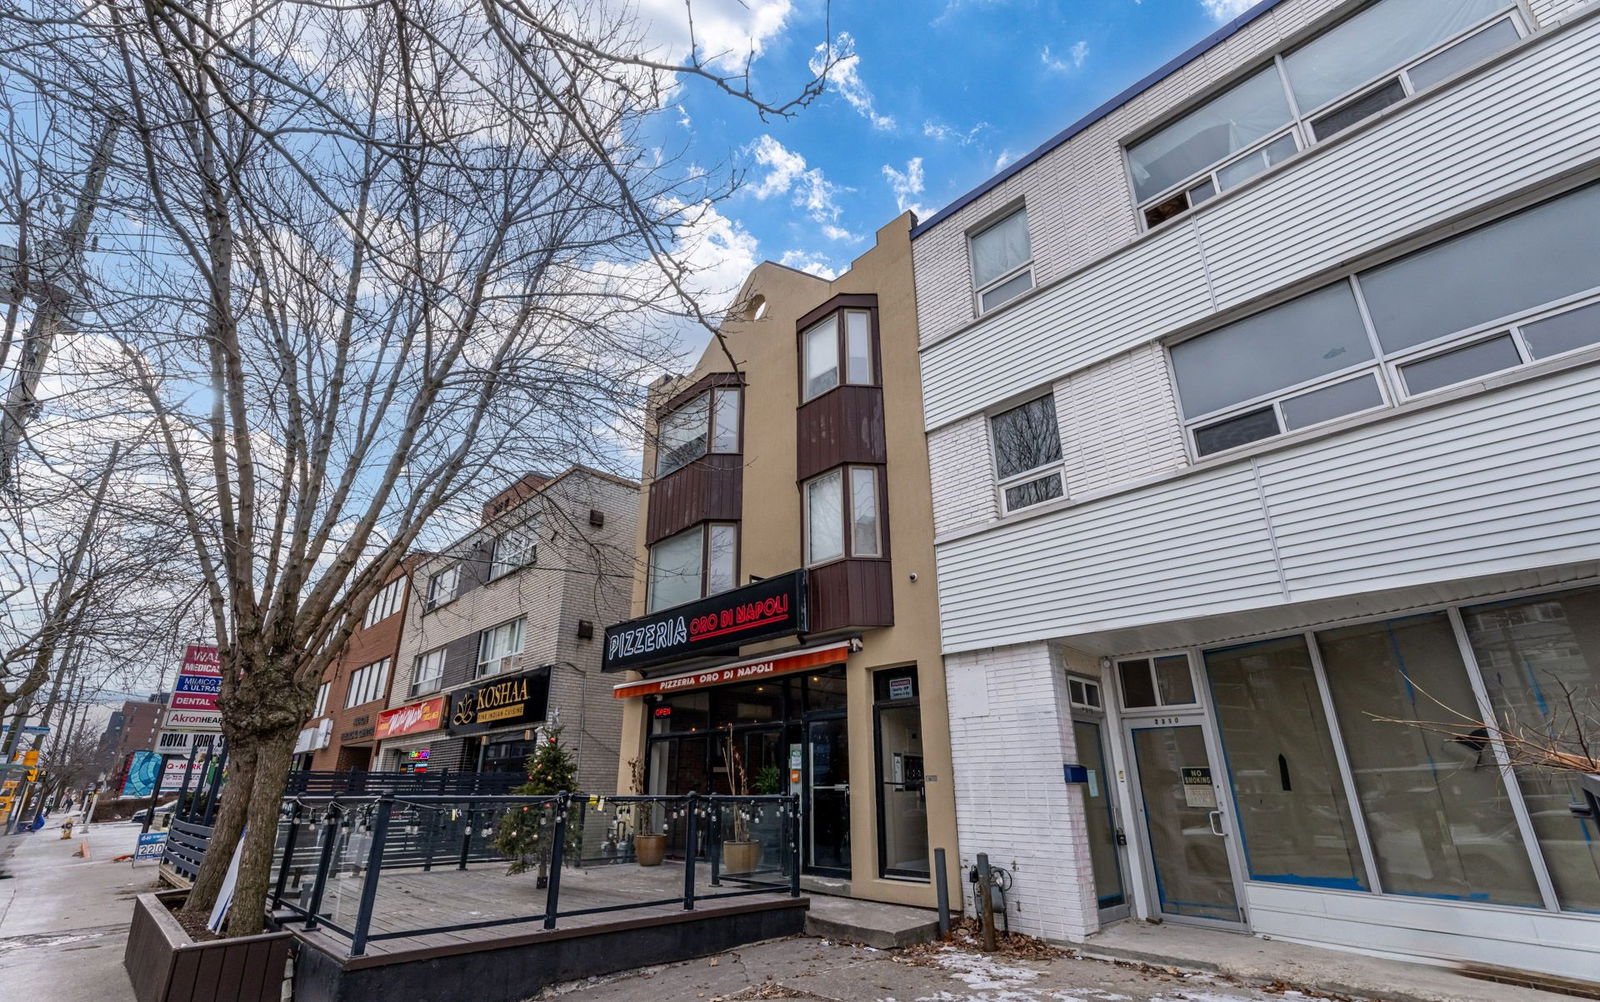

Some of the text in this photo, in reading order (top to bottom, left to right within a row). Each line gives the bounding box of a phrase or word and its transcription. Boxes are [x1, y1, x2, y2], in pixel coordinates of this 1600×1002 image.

[609, 593, 788, 660] PIZZERIA ORO DI NAPOLI
[184, 677, 216, 686] MIMICO
[660, 662, 774, 690] PIZZERIA ORO DI NAPOLI
[476, 678, 529, 710] KOSHAA
[176, 697, 211, 706] DENTAL
[488, 708, 503, 719] INDIAN
[655, 707, 671, 716] OPEN
[160, 733, 188, 747] ROYAL
[193, 734, 215, 748] YORK
[1185, 776, 1211, 784] SMOKING
